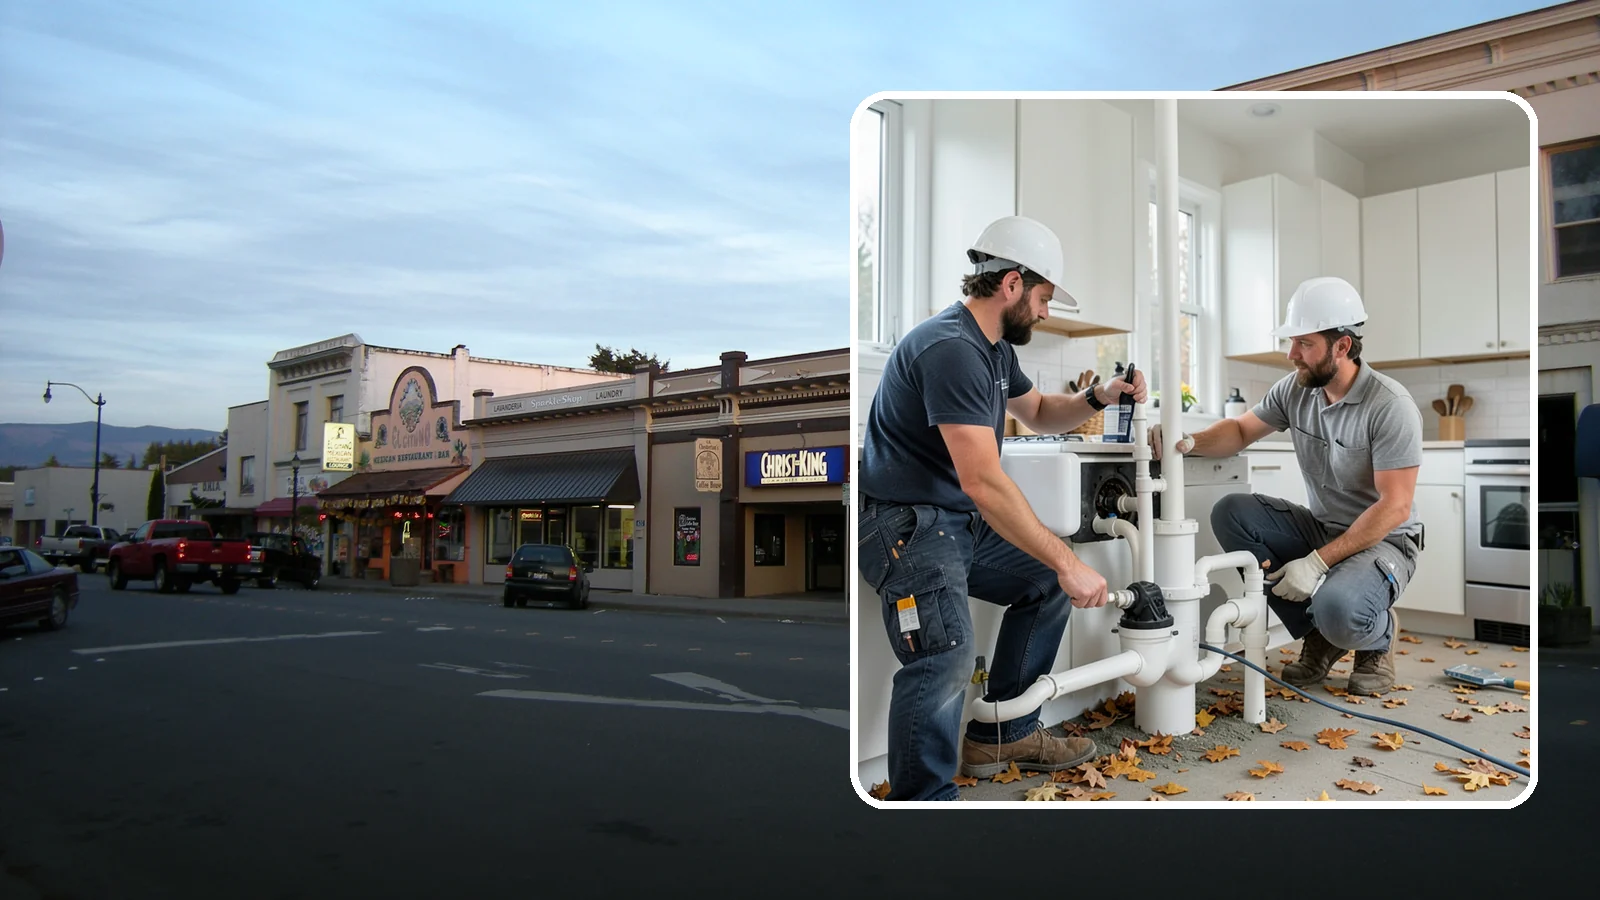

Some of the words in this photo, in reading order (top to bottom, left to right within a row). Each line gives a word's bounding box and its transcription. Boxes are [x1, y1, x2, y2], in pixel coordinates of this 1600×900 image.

[562, 394, 583, 405] Shop
[595, 389, 624, 400] LAUNDRY
[493, 402, 523, 413] LAVANDERIA
[373, 454, 396, 464] MEXICAN
[397, 451, 434, 462] RESTAURANT
[438, 449, 450, 459] BAR
[760, 452, 797, 478] CHRIST
[799, 450, 827, 476] KING
[696, 480, 709, 488] Coffee
[710, 480, 722, 489] House
